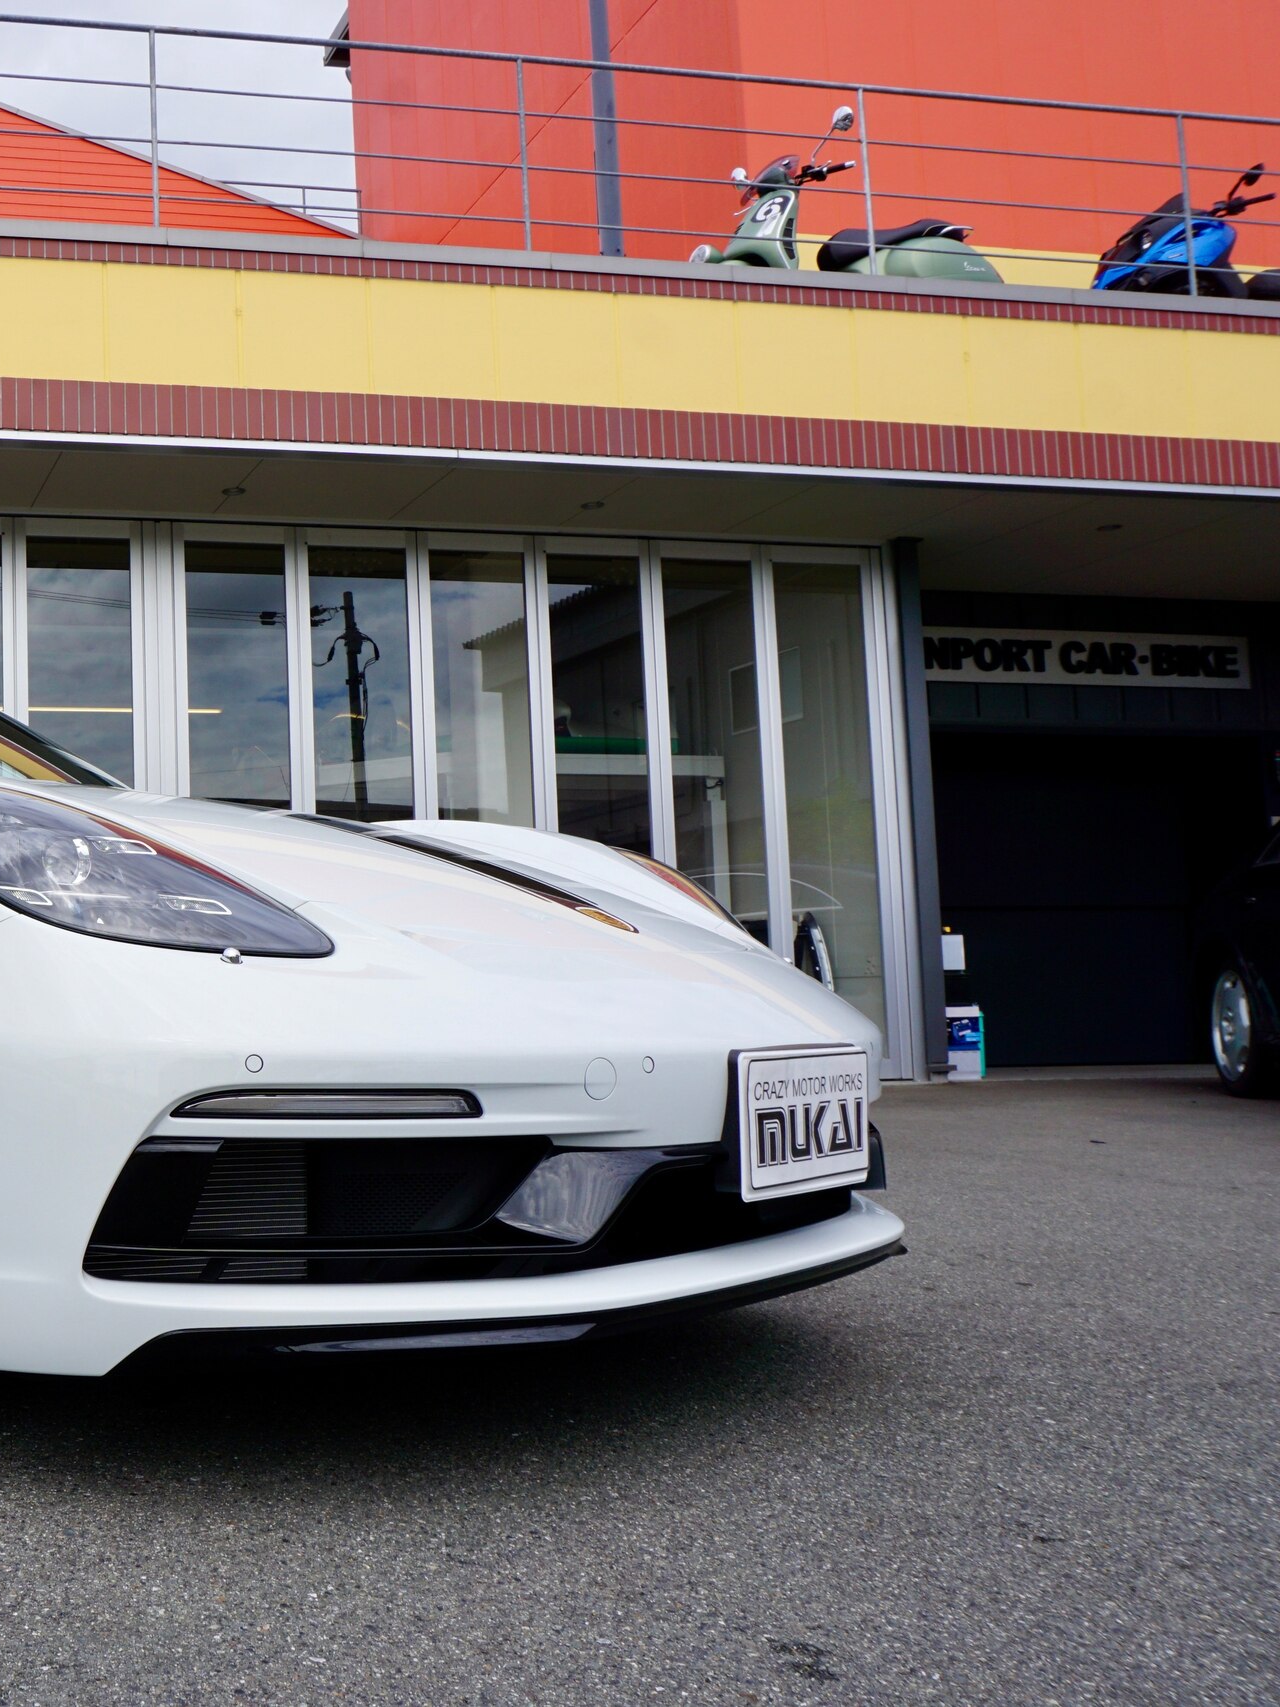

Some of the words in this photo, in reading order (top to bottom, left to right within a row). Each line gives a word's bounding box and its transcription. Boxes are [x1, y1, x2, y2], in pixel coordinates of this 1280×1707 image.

[754, 1080, 790, 1101] CRAZY
[792, 1076, 826, 1097] MOTOR
[829, 1073, 863, 1094] WORKS
